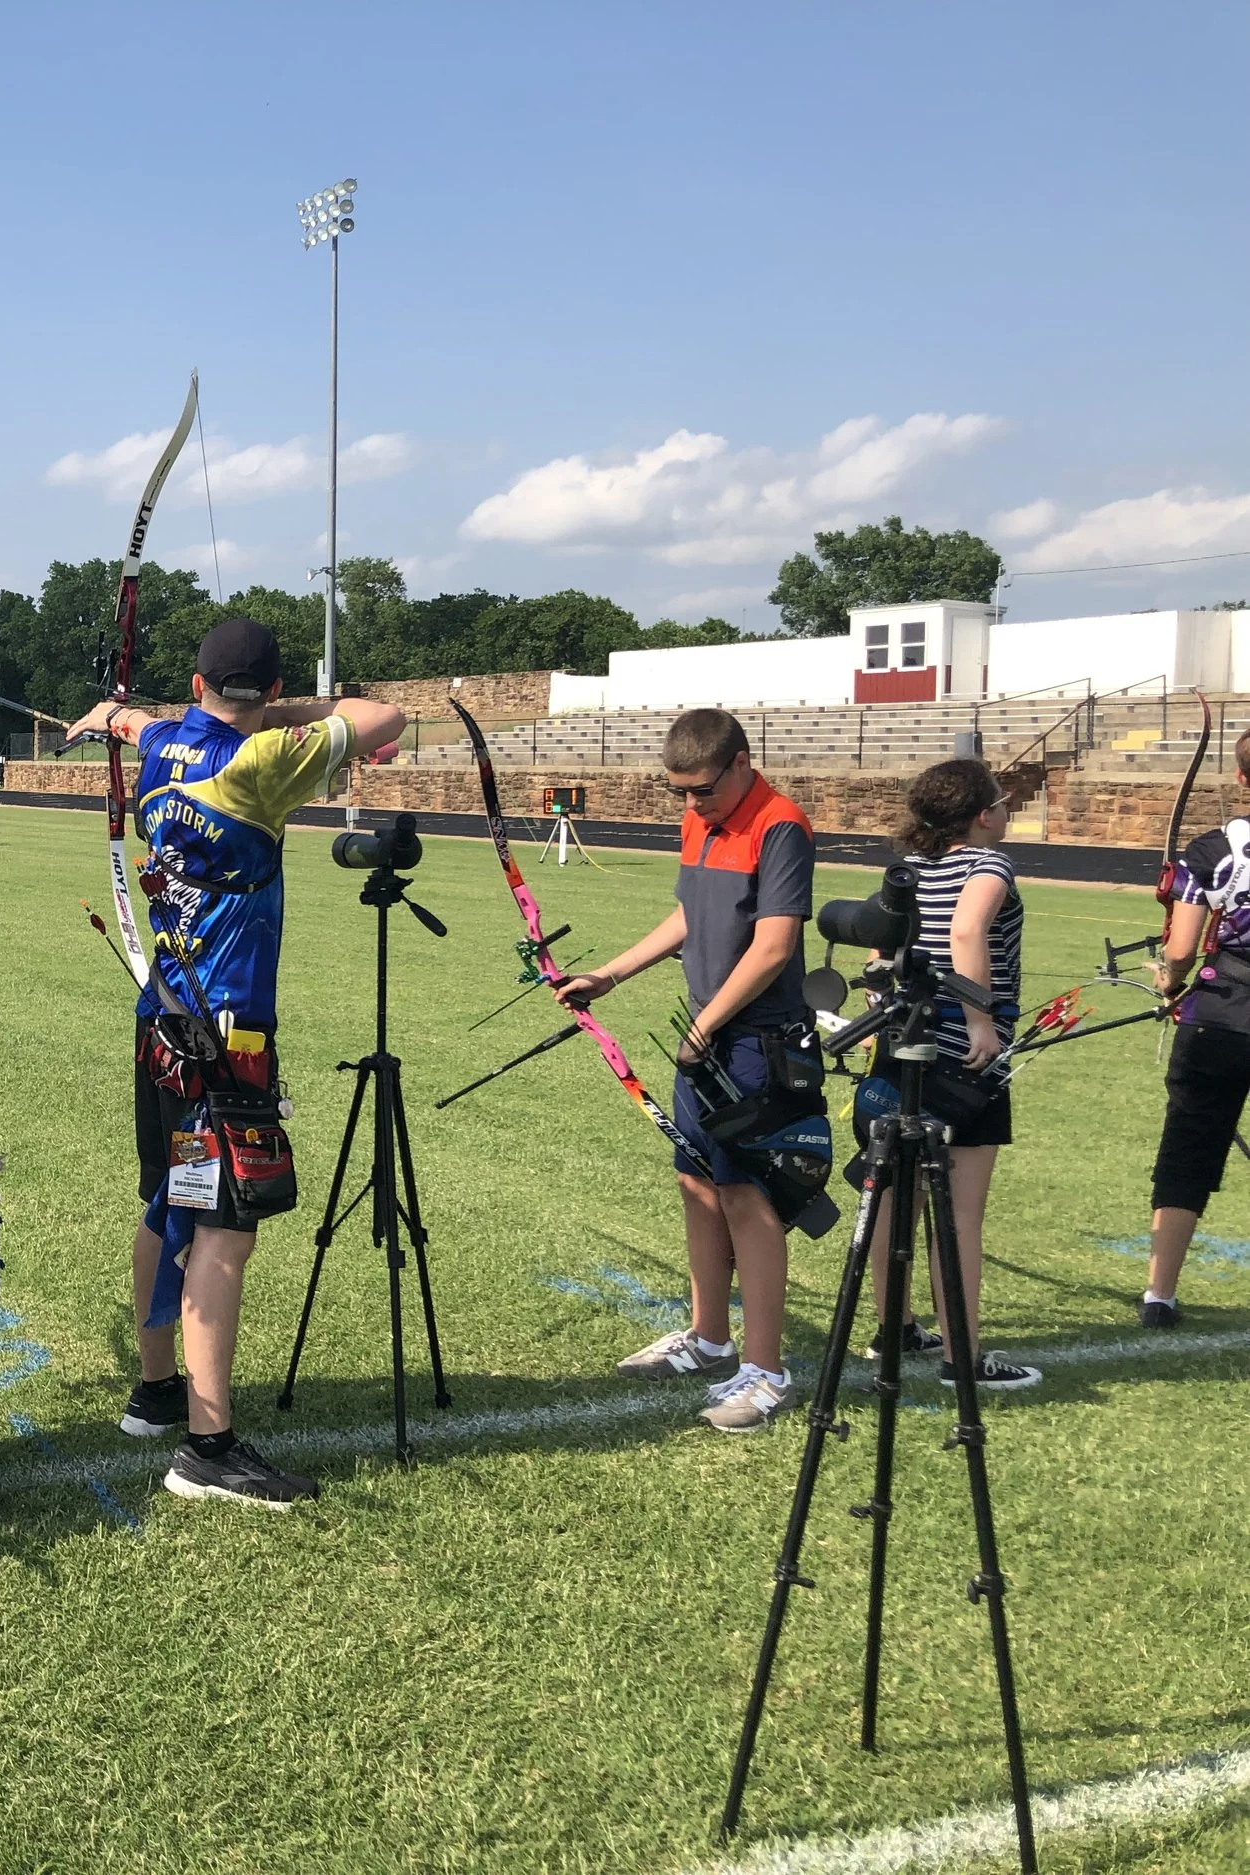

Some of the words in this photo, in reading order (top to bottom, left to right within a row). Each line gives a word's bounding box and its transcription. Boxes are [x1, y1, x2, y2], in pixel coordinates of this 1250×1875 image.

[129, 501, 153, 559] HOYT
[166, 799, 225, 843] STORM
[111, 851, 129, 898] HOYT
[1222, 863, 1247, 903] EASTON
[797, 1134, 829, 1145] EASTON
[665, 1350, 699, 1373] N
[749, 1388, 779, 1415] N
